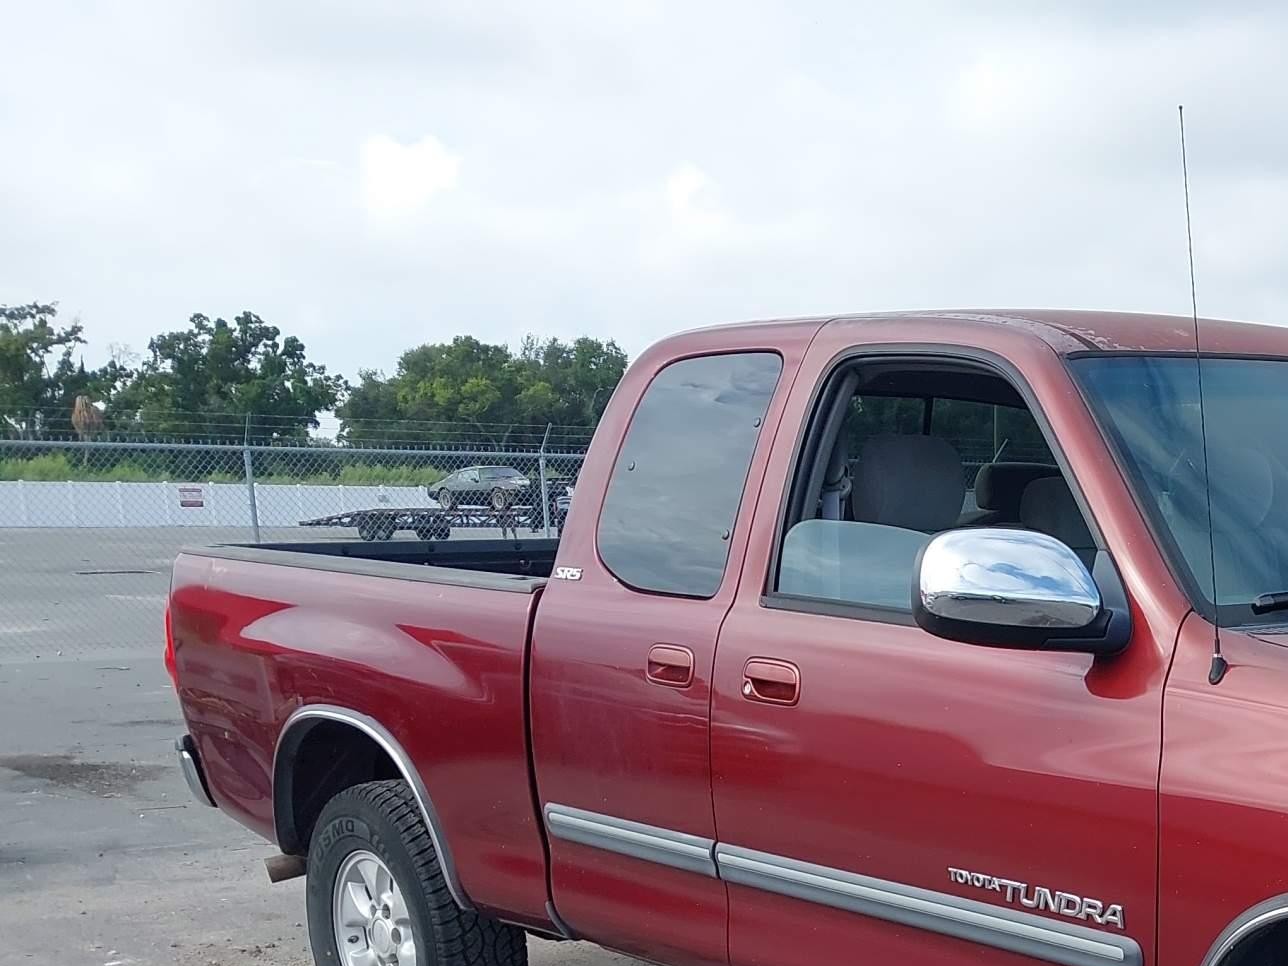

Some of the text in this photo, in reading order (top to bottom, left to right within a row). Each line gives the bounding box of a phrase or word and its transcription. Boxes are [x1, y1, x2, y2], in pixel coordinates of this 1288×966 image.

[555, 567, 582, 580] SR5
[947, 867, 1125, 929] TOYOTA TUNDRA
